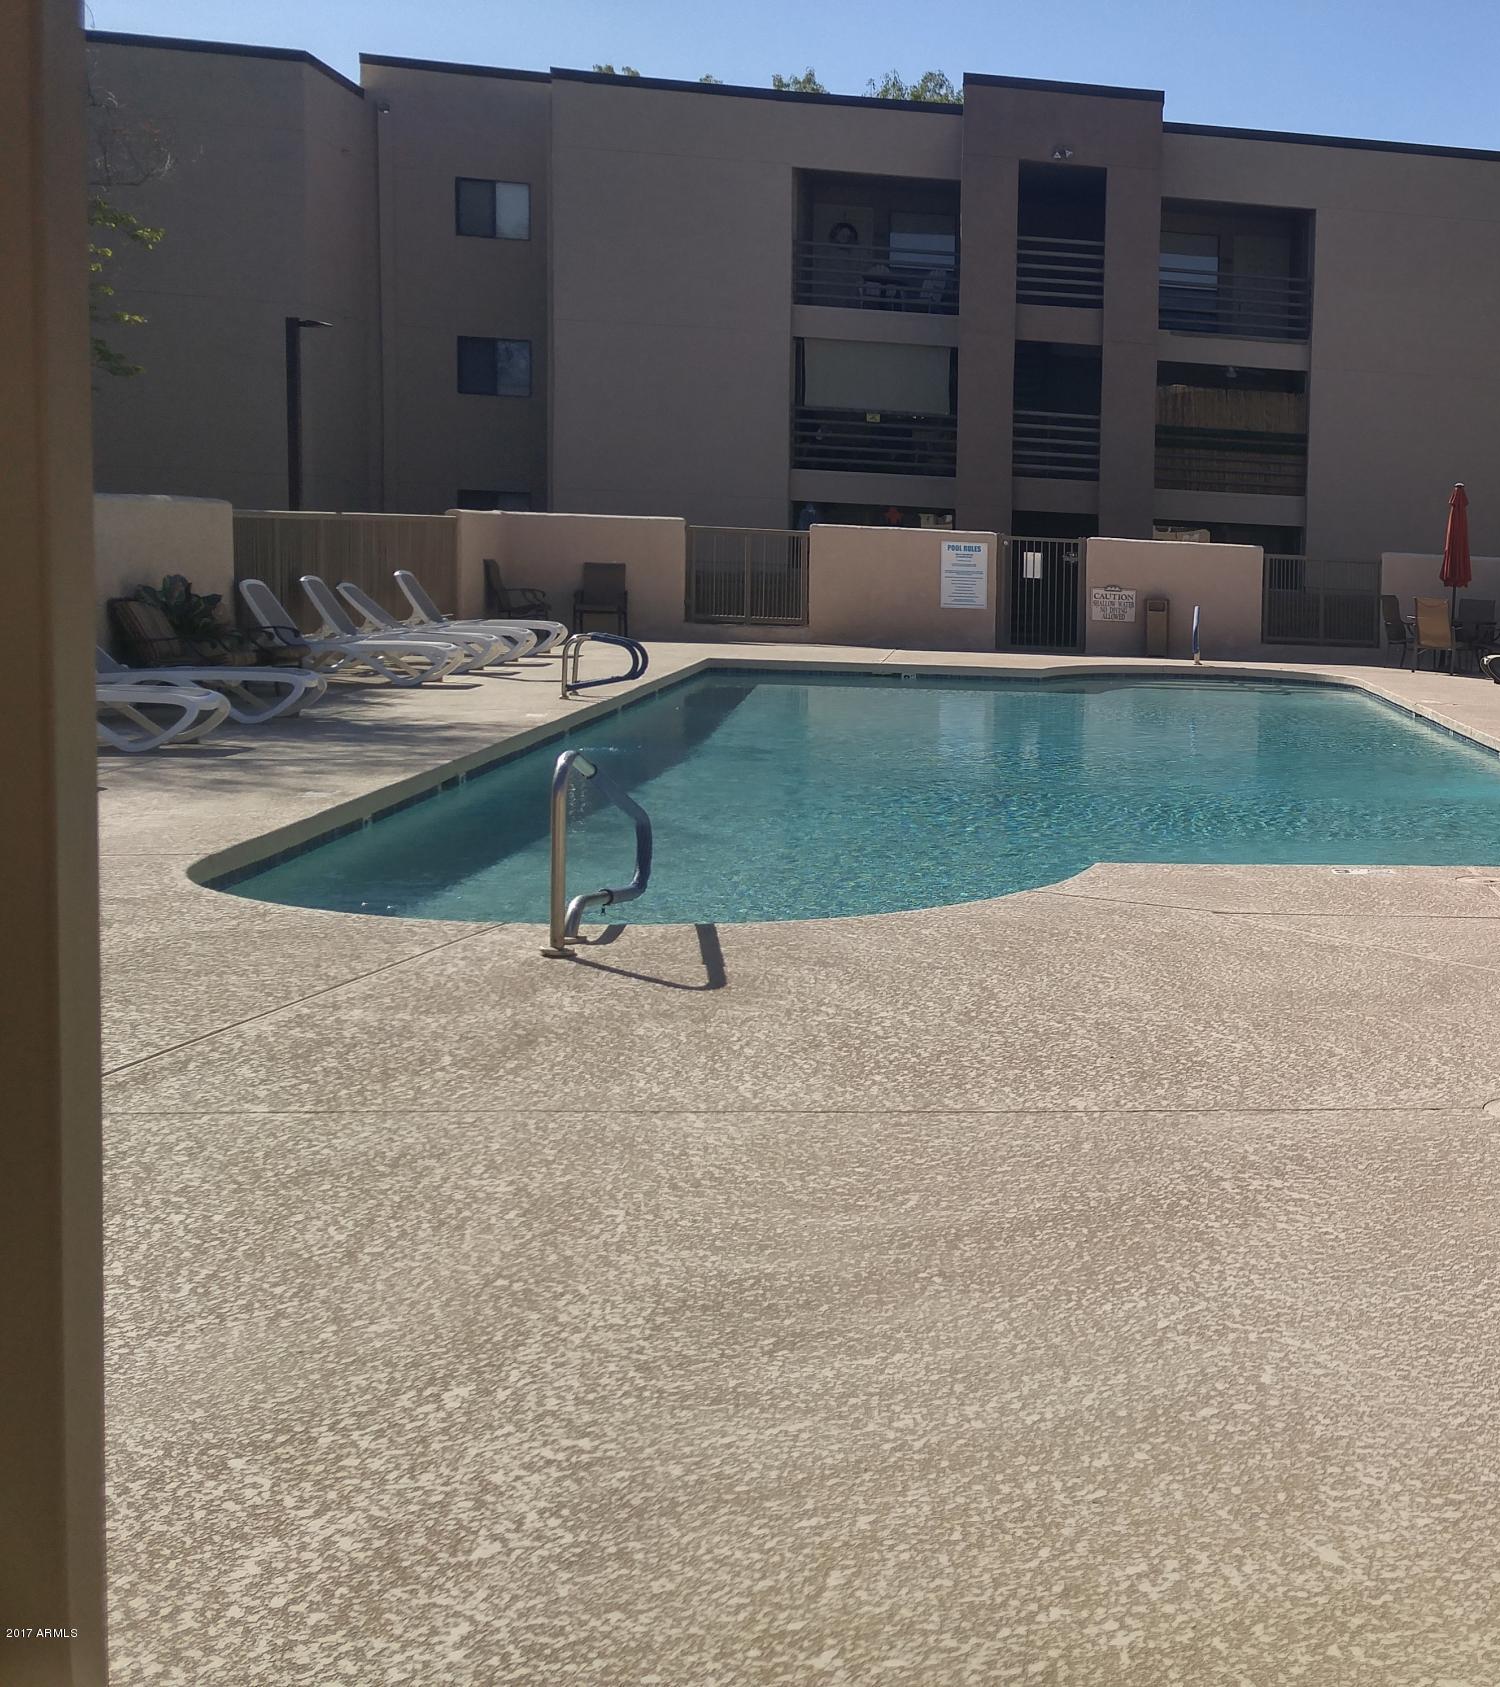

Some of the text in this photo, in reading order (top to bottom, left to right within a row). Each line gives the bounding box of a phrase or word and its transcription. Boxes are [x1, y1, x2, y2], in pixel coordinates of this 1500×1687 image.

[947, 544, 982, 553] POOL RULES
[1093, 593, 1134, 601] CAUTION
